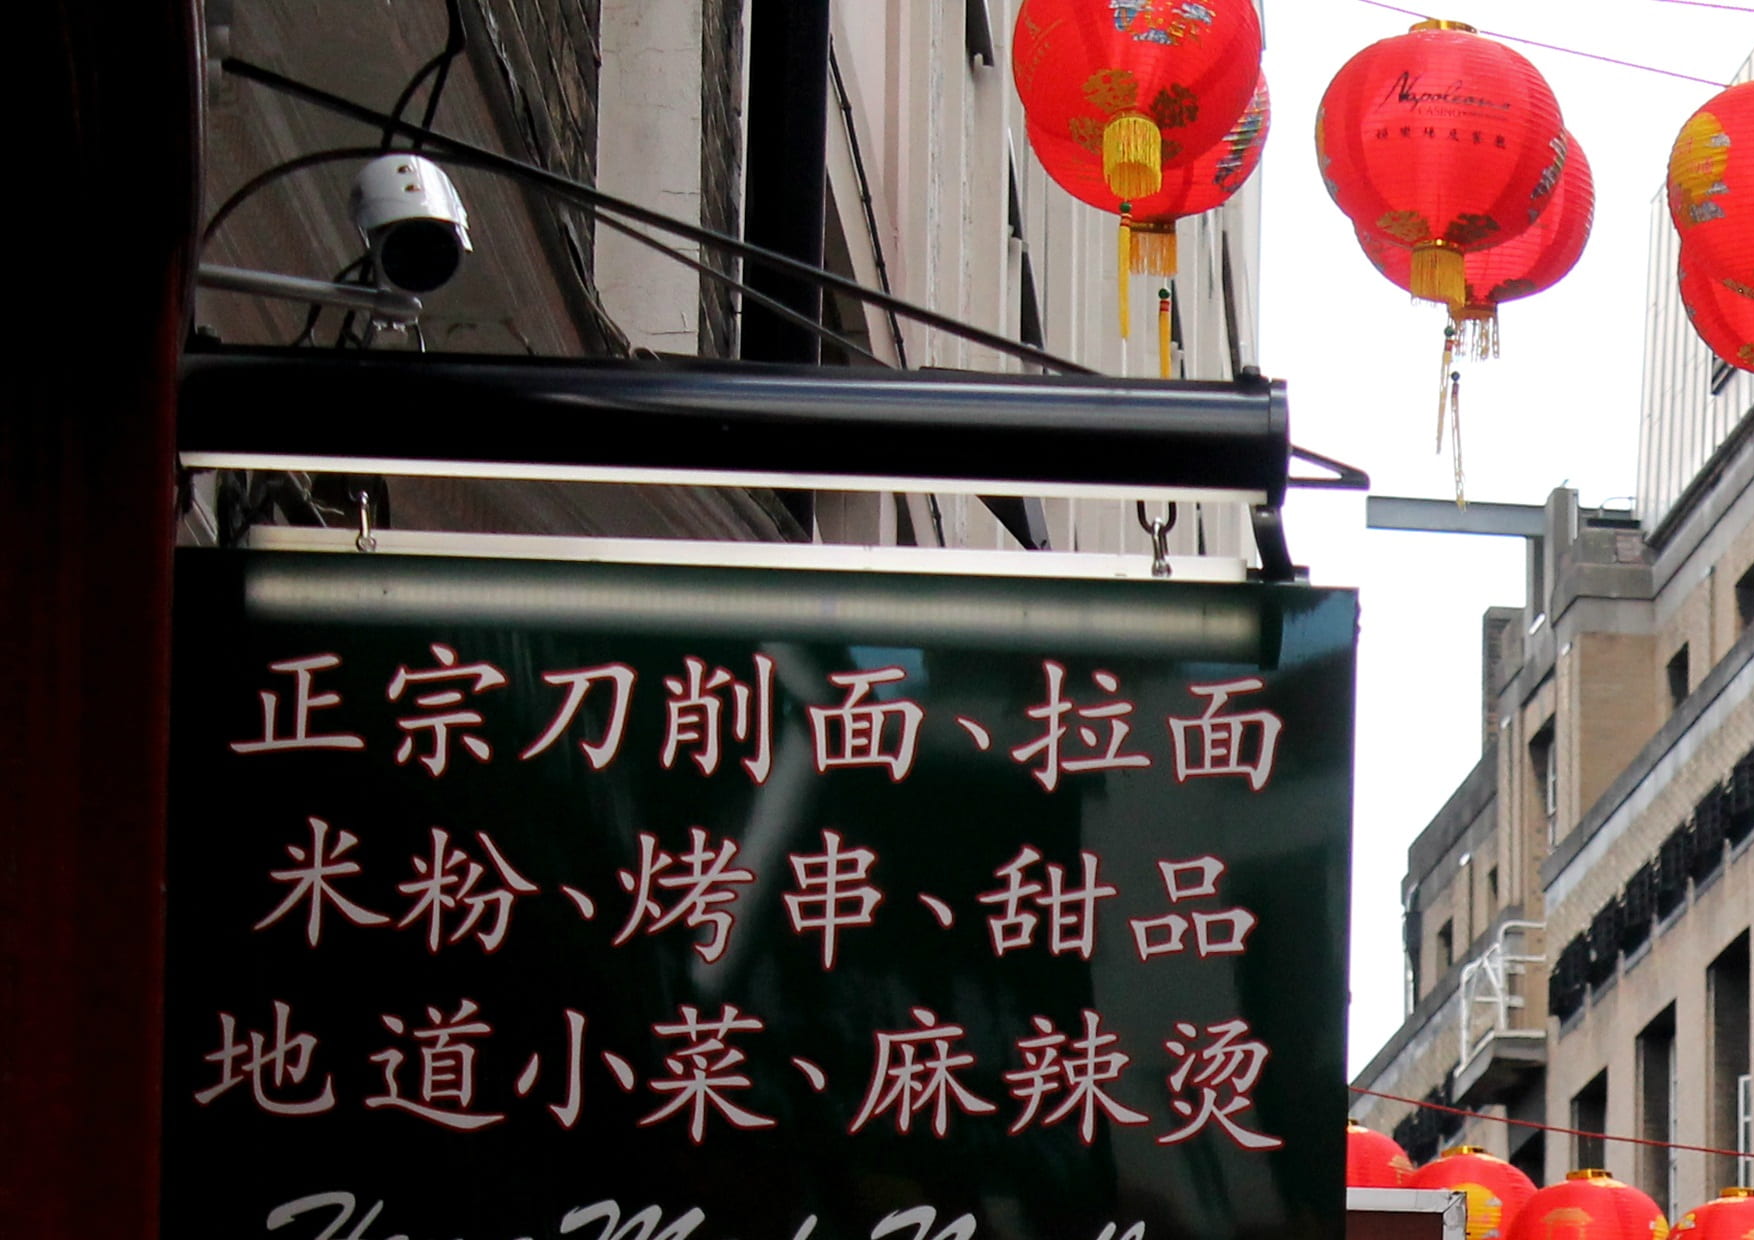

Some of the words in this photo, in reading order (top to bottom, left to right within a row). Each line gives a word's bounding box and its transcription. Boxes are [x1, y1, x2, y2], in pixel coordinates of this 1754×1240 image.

[229, 643, 1284, 794] 正宗刀削面、拉面
[253, 816, 1258, 970] 米粉、烤串、甜品
[193, 1000, 1284, 1150] 地道小菜、麻辣烫
